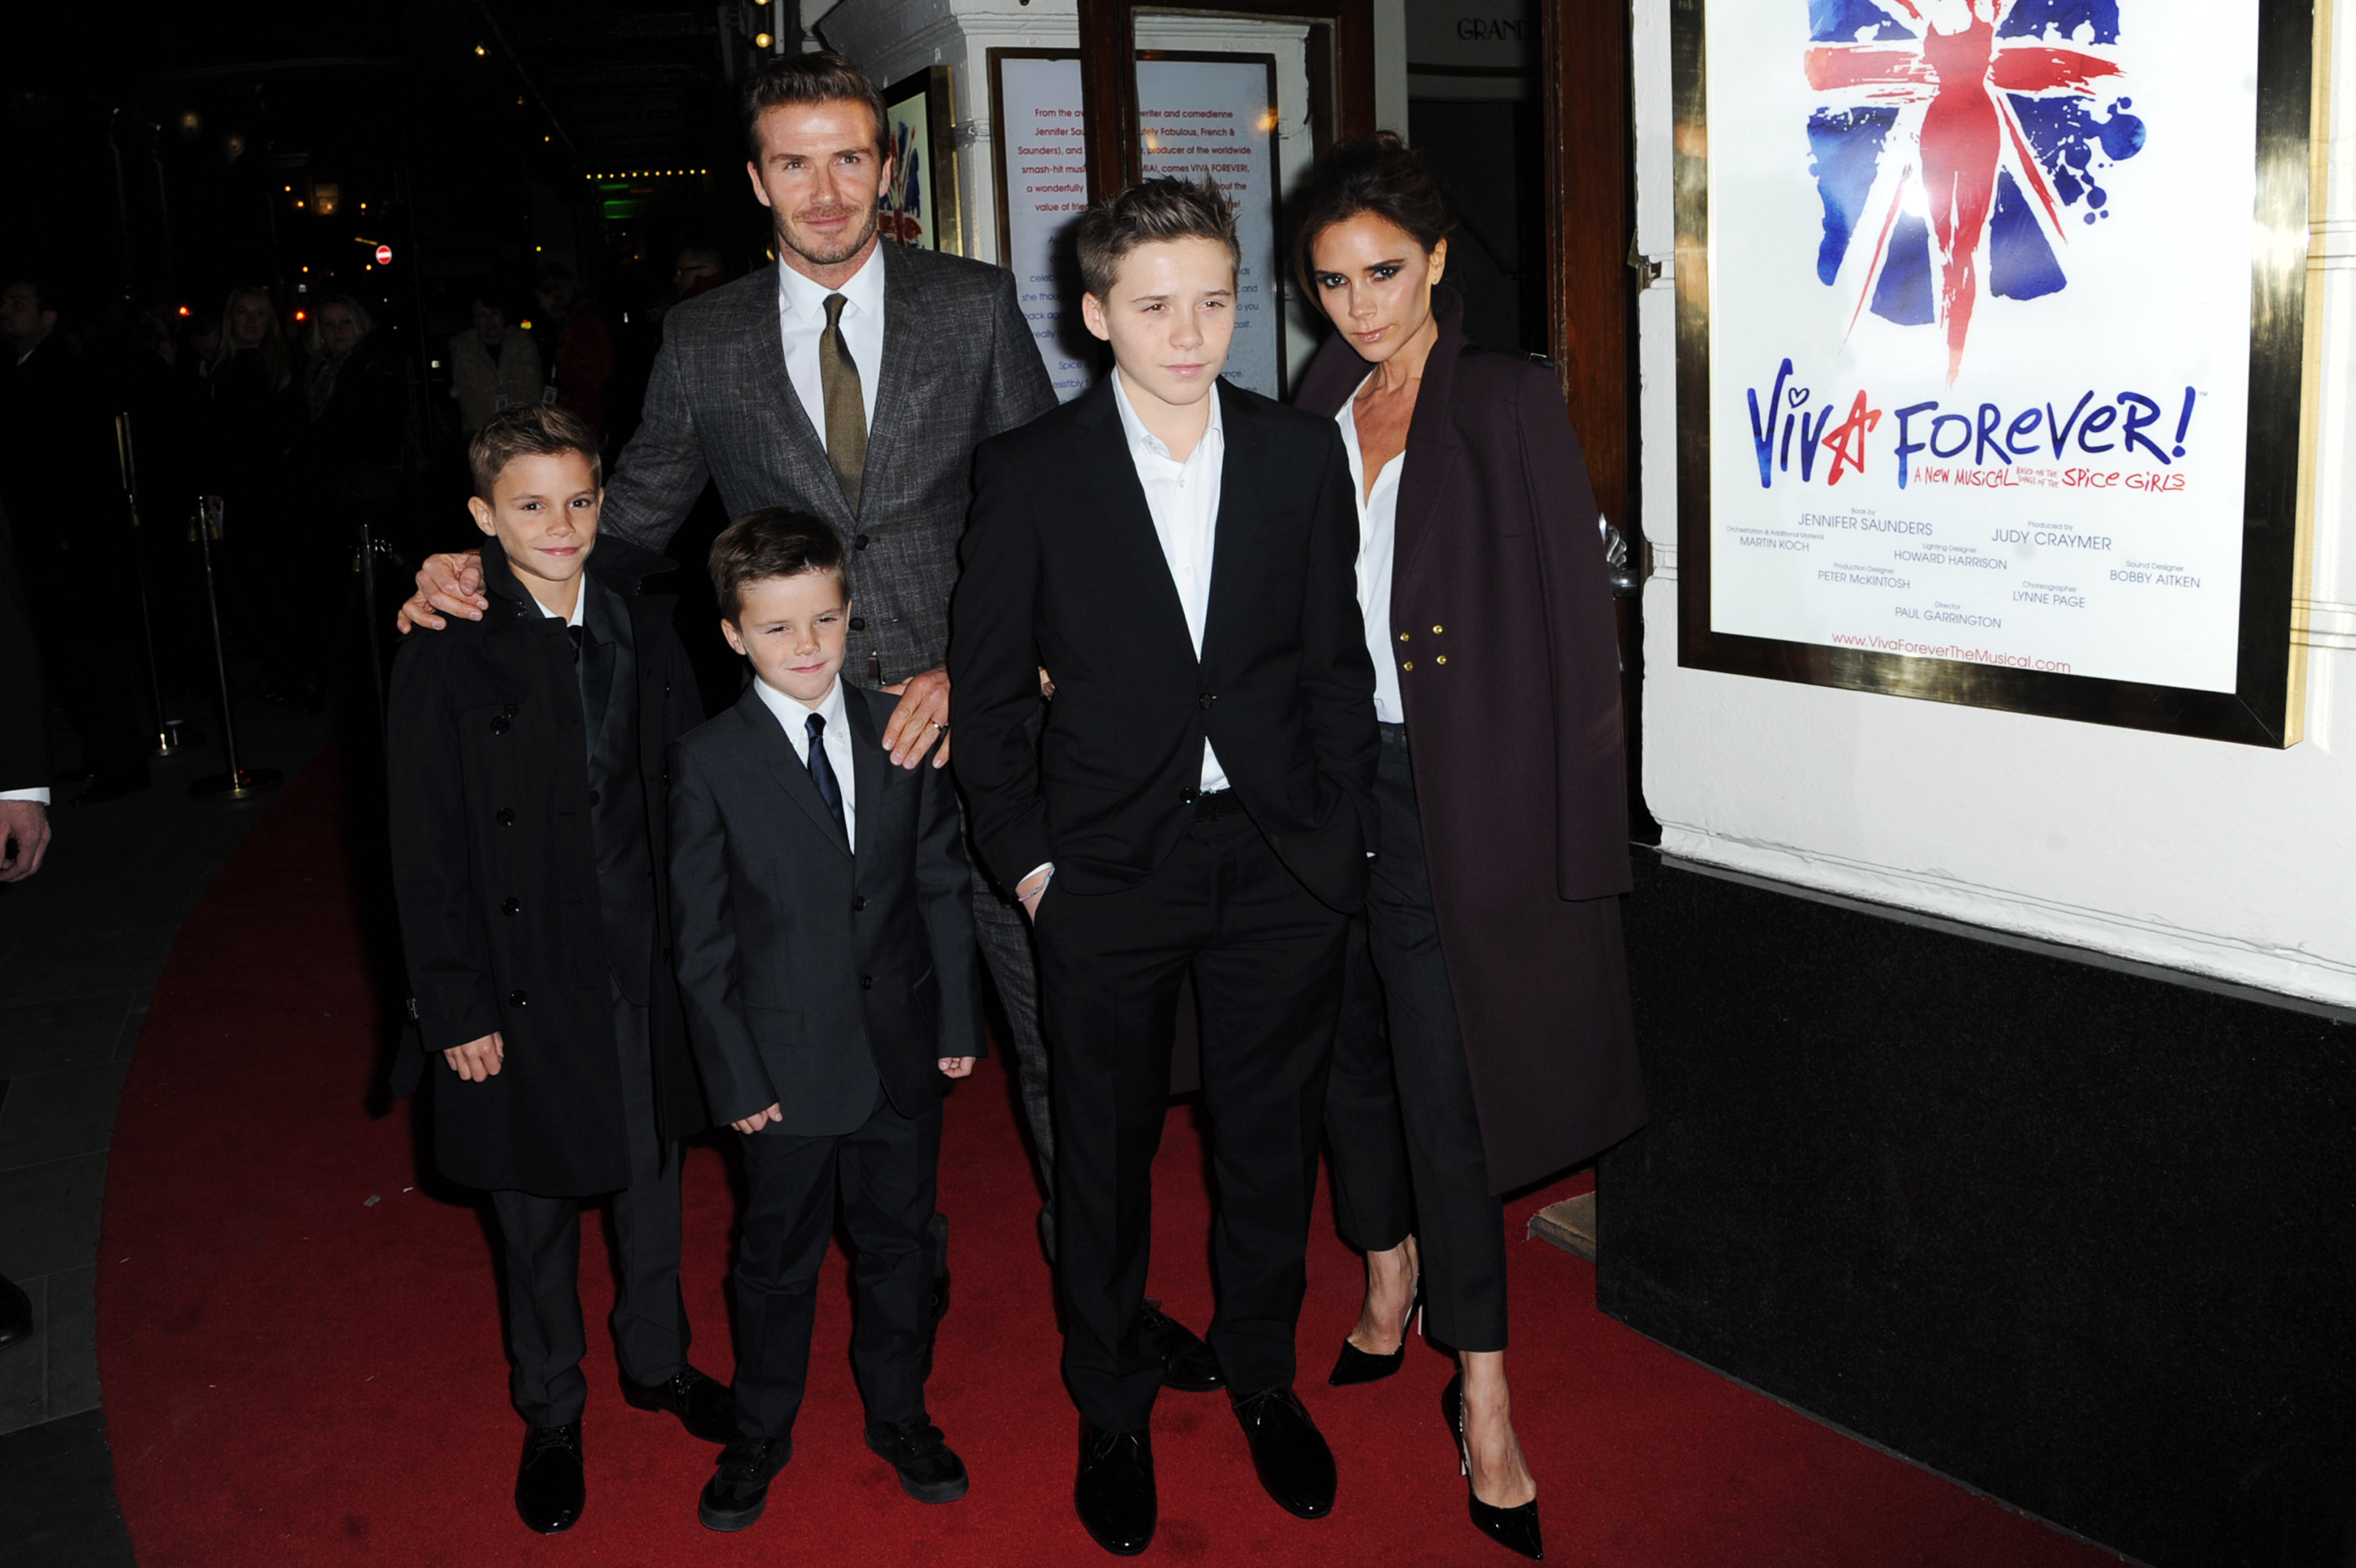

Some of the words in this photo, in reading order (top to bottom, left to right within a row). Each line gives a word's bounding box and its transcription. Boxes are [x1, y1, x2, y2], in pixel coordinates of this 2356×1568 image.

[1035, 108, 1056, 117] From
[1035, 127, 1068, 136] Jennifer
[1161, 128, 1199, 137] Fabulous,
[1018, 146, 1064, 156] Saunders),
[1147, 146, 1184, 155] producer
[1212, 164, 1250, 173] FOREVER!,
[1035, 184, 1084, 194] wonderfully
[1035, 203, 1059, 211] value
[1061, 203, 1070, 211] of
[1072, 203, 1089, 211] frien
[1030, 274, 1055, 283] celeb
[1022, 293, 1037, 302] she
[1039, 292, 1059, 301] thou
[1245, 303, 1259, 313] you
[1059, 360, 1082, 371] Spice
[1914, 466, 1922, 483] A
[1798, 513, 1857, 530] JENNIFER
[1860, 517, 1933, 536] SAUNDERS
[2027, 521, 2063, 530] Produced
[2064, 523, 2074, 532] by
[1726, 525, 1764, 535] Orchestration
[1770, 529, 1799, 538] Additional
[1740, 535, 1776, 549] MARTIN
[1779, 539, 1809, 551] KOCH
[1991, 528, 2030, 544] JUDY
[2034, 532, 2112, 550] CRAYMER
[1922, 543, 1948, 552] Lighting
[1948, 545, 1977, 554] Designer
[1893, 550, 1945, 565] HOWARD
[1948, 554, 2007, 570] HARRISON
[2126, 560, 2150, 569] Sound
[2151, 562, 2184, 572] Designer
[1833, 561, 1867, 572] Production
[1868, 565, 1895, 574] Designer
[1818, 570, 1847, 583] PETER
[1849, 573, 1911, 590] McKINTOSH
[2109, 569, 2153, 583] BOBBY
[2155, 574, 2201, 588] AITKEN
[2022, 580, 2077, 593] Choreographer
[1934, 601, 1961, 610] Director
[2012, 590, 2050, 605] LYNNE
[2052, 594, 2086, 609] PAGE
[1895, 606, 1921, 620] PAUL
[1923, 610, 2002, 629] GARRINGTON
[1831, 633, 2072, 674] www.VivaForeverTheMusical.com
